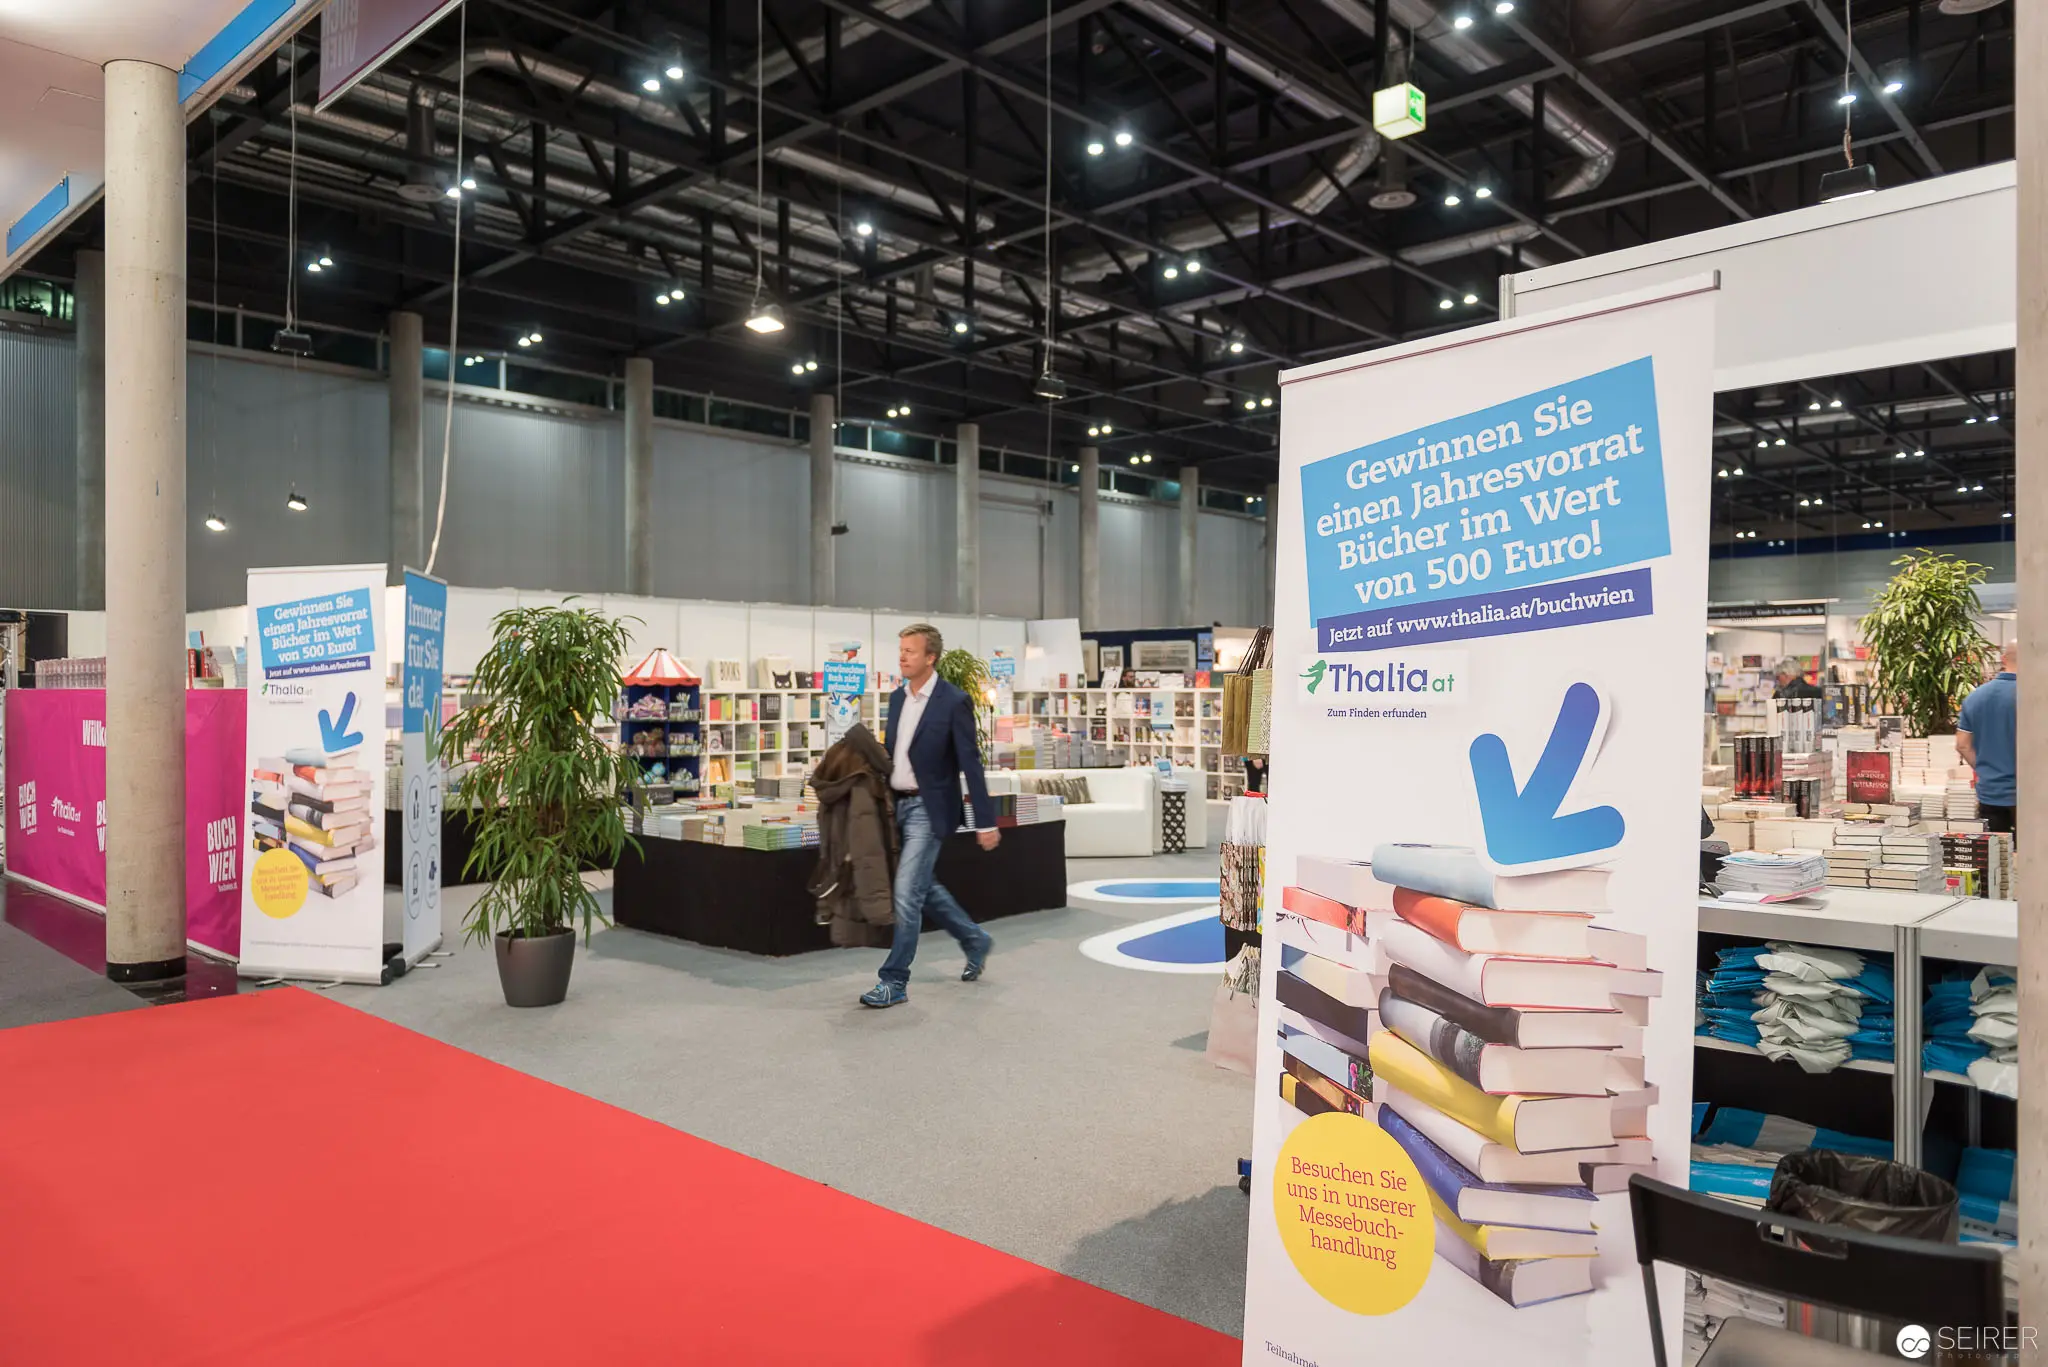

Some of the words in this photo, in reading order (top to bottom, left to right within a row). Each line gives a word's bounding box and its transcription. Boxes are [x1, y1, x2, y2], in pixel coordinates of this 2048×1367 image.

[1346, 419, 1522, 491] Gewinnen
[1533, 395, 1594, 439] Sie
[1316, 490, 1402, 537] einen
[1411, 423, 1645, 521] Jahresvorrat
[1337, 517, 1450, 571] Bücher
[1459, 507, 1512, 544] im
[1520, 475, 1622, 526] Wert
[1355, 569, 1417, 605] von
[1427, 548, 1492, 591] 500
[1504, 518, 1604, 576] Euro!
[263, 622, 295, 637] einen
[297, 608, 368, 633] Jahresvorrat
[274, 601, 333, 620] Gewinnen
[335, 594, 354, 609] Sie
[408, 595, 443, 632] Immer
[1328, 624, 1363, 648] Jetzt
[1366, 618, 1394, 640] auf
[1396, 586, 1635, 636] www.thalia.at/buchwien
[272, 634, 310, 650] Bücher
[313, 629, 330, 643] im
[332, 623, 362, 639] Wert
[278, 651, 300, 663] von
[302, 644, 324, 659] 500
[327, 637, 357, 655] Euro!
[408, 633, 425, 668] für
[424, 638, 439, 670] Sie
[408, 675, 424, 709] da!
[1327, 707, 1347, 718] Zum
[1349, 707, 1380, 718] Finden
[1382, 707, 1427, 719] erfunden
[82, 719, 107, 748] Willk
[18, 780, 37, 808] BUCH
[19, 803, 37, 830] WIEN
[207, 815, 237, 852] BUCH
[208, 848, 236, 884] WIEN
[1290, 1156, 1375, 1186] Besuchen
[1380, 1170, 1408, 1192] Sie
[1287, 1181, 1318, 1201] uns
[1322, 1184, 1341, 1205] in
[1346, 1192, 1417, 1218] unserer
[1299, 1204, 1405, 1240] Messebuch-
[1309, 1229, 1398, 1270] handlung
